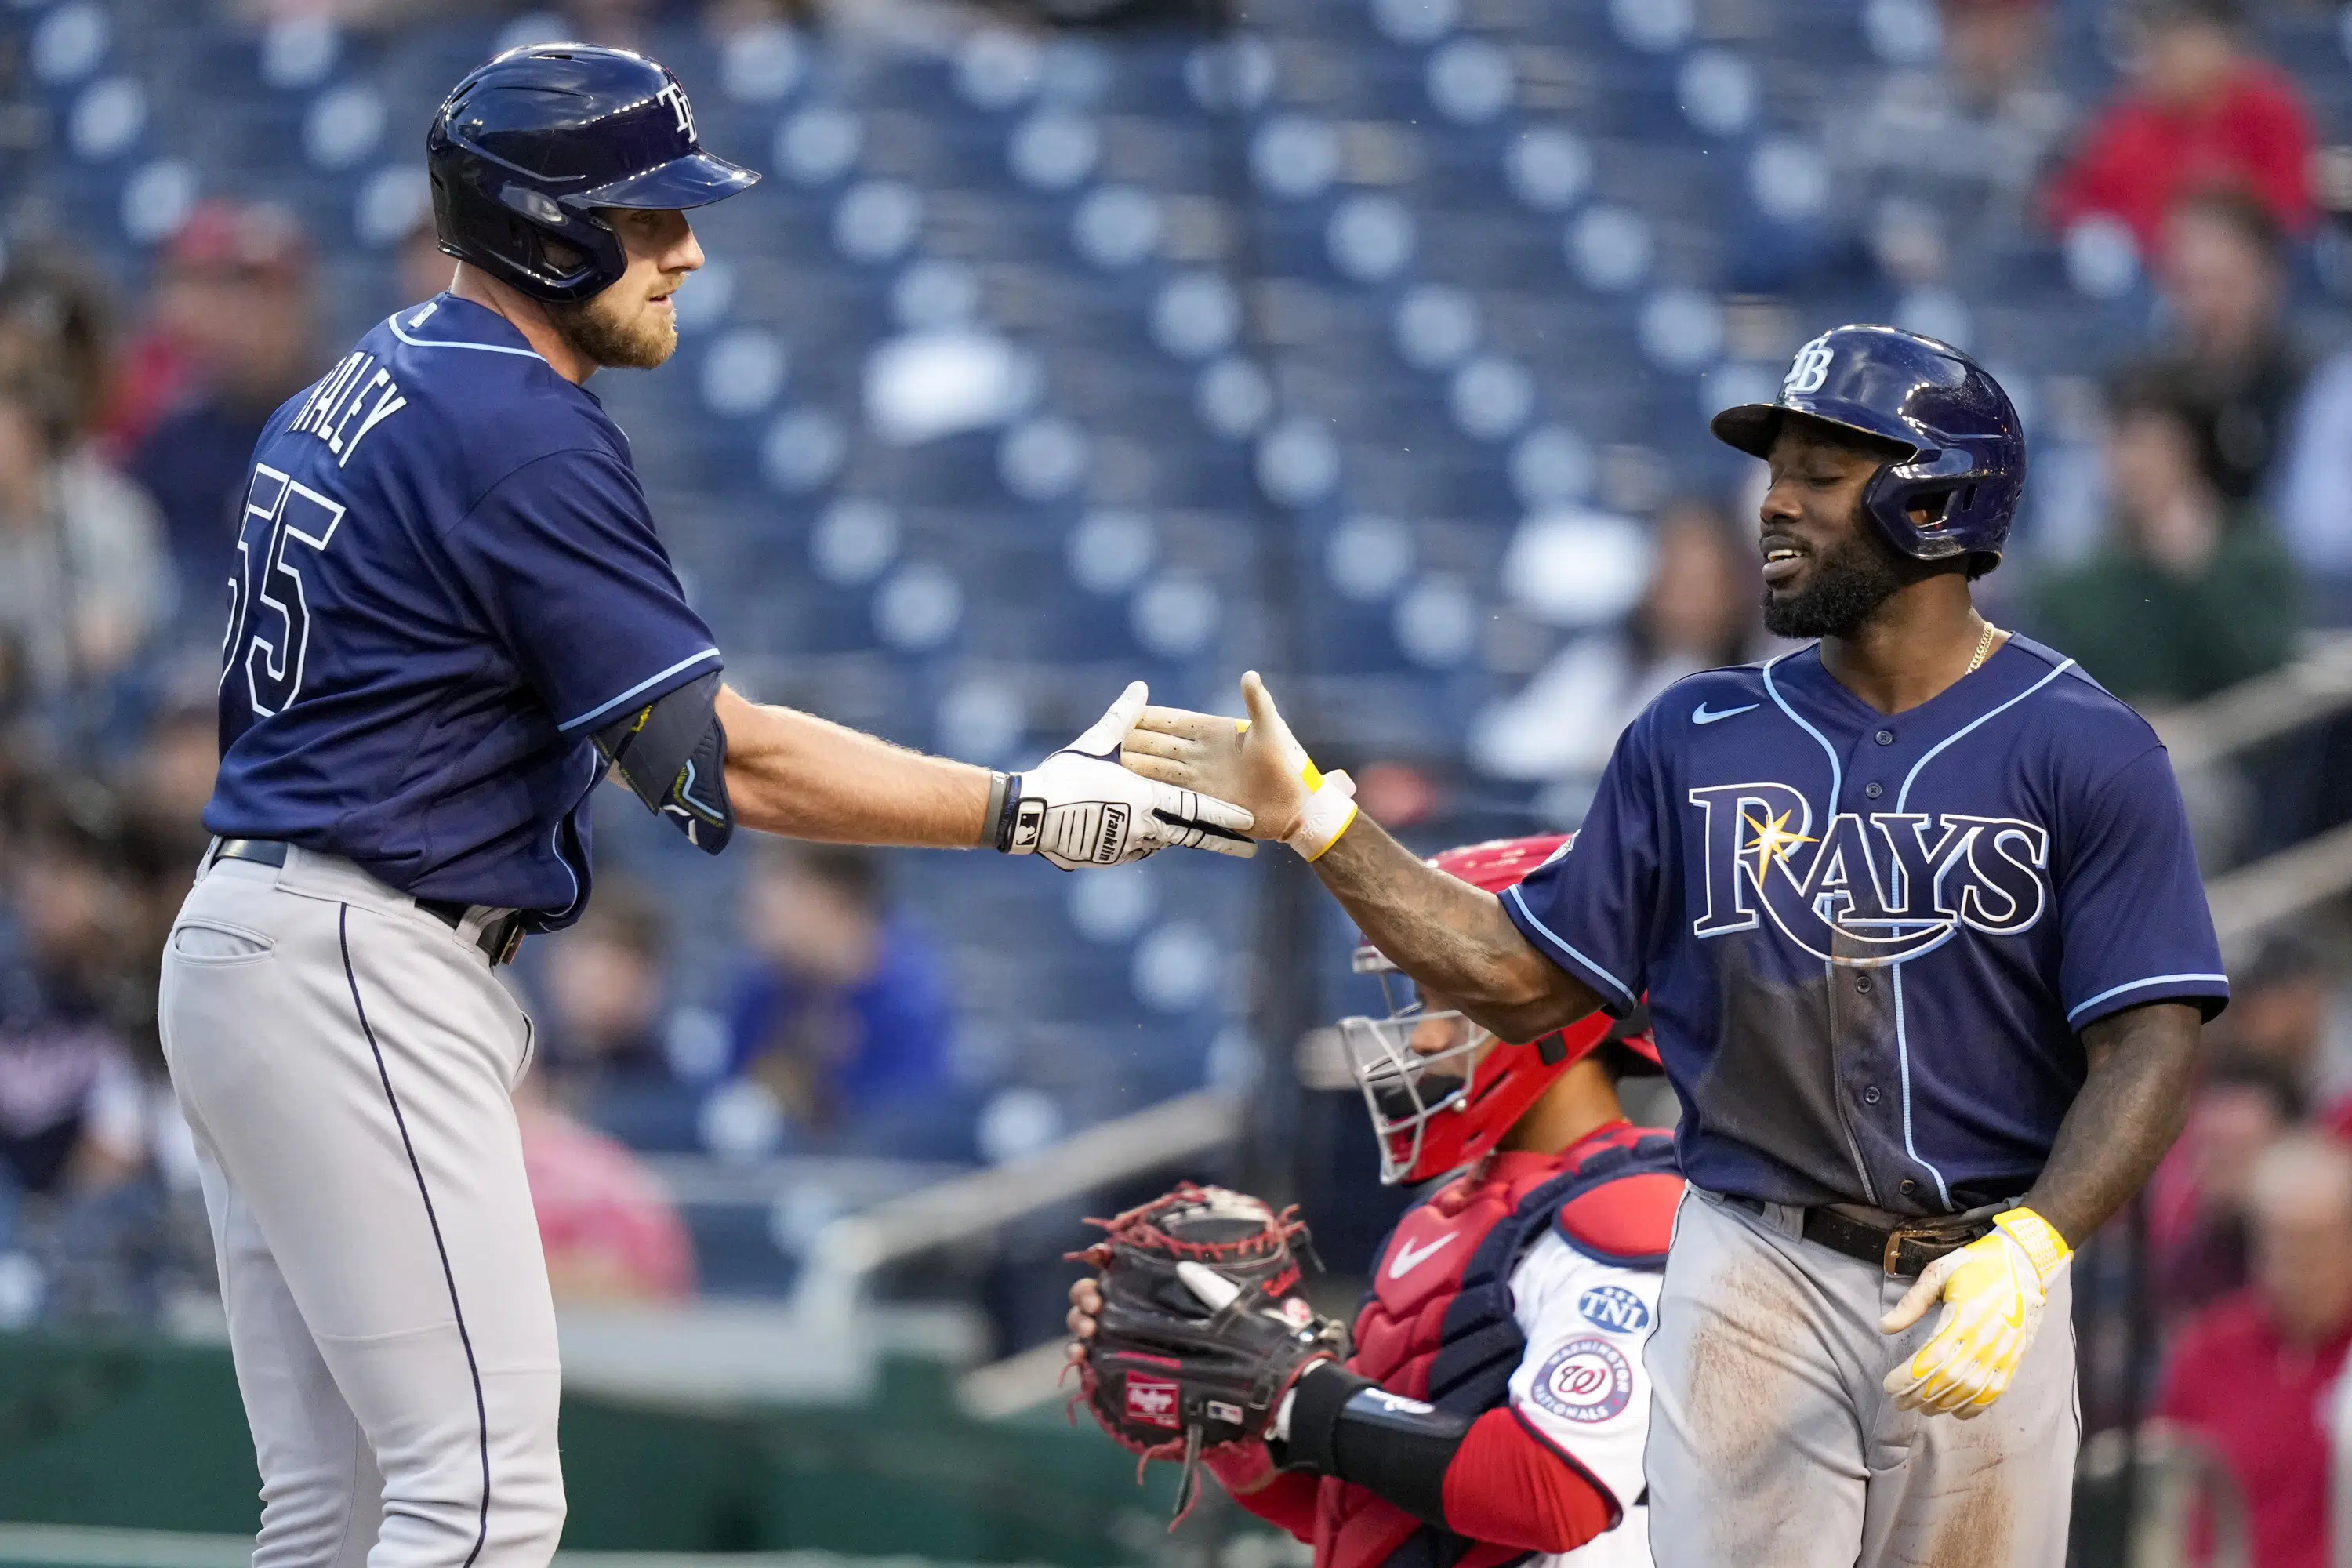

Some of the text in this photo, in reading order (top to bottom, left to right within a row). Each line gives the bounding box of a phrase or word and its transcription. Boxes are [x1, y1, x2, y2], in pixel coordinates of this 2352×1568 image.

[1784, 336, 1834, 394] TB
[287, 351, 407, 468] RALEY
[1689, 782, 2049, 967] RAYS
[1580, 1292, 1647, 1332] TNL
[1548, 1339, 1630, 1392] WASHINGTON
[1533, 1384, 1609, 1420] NATIONALS
